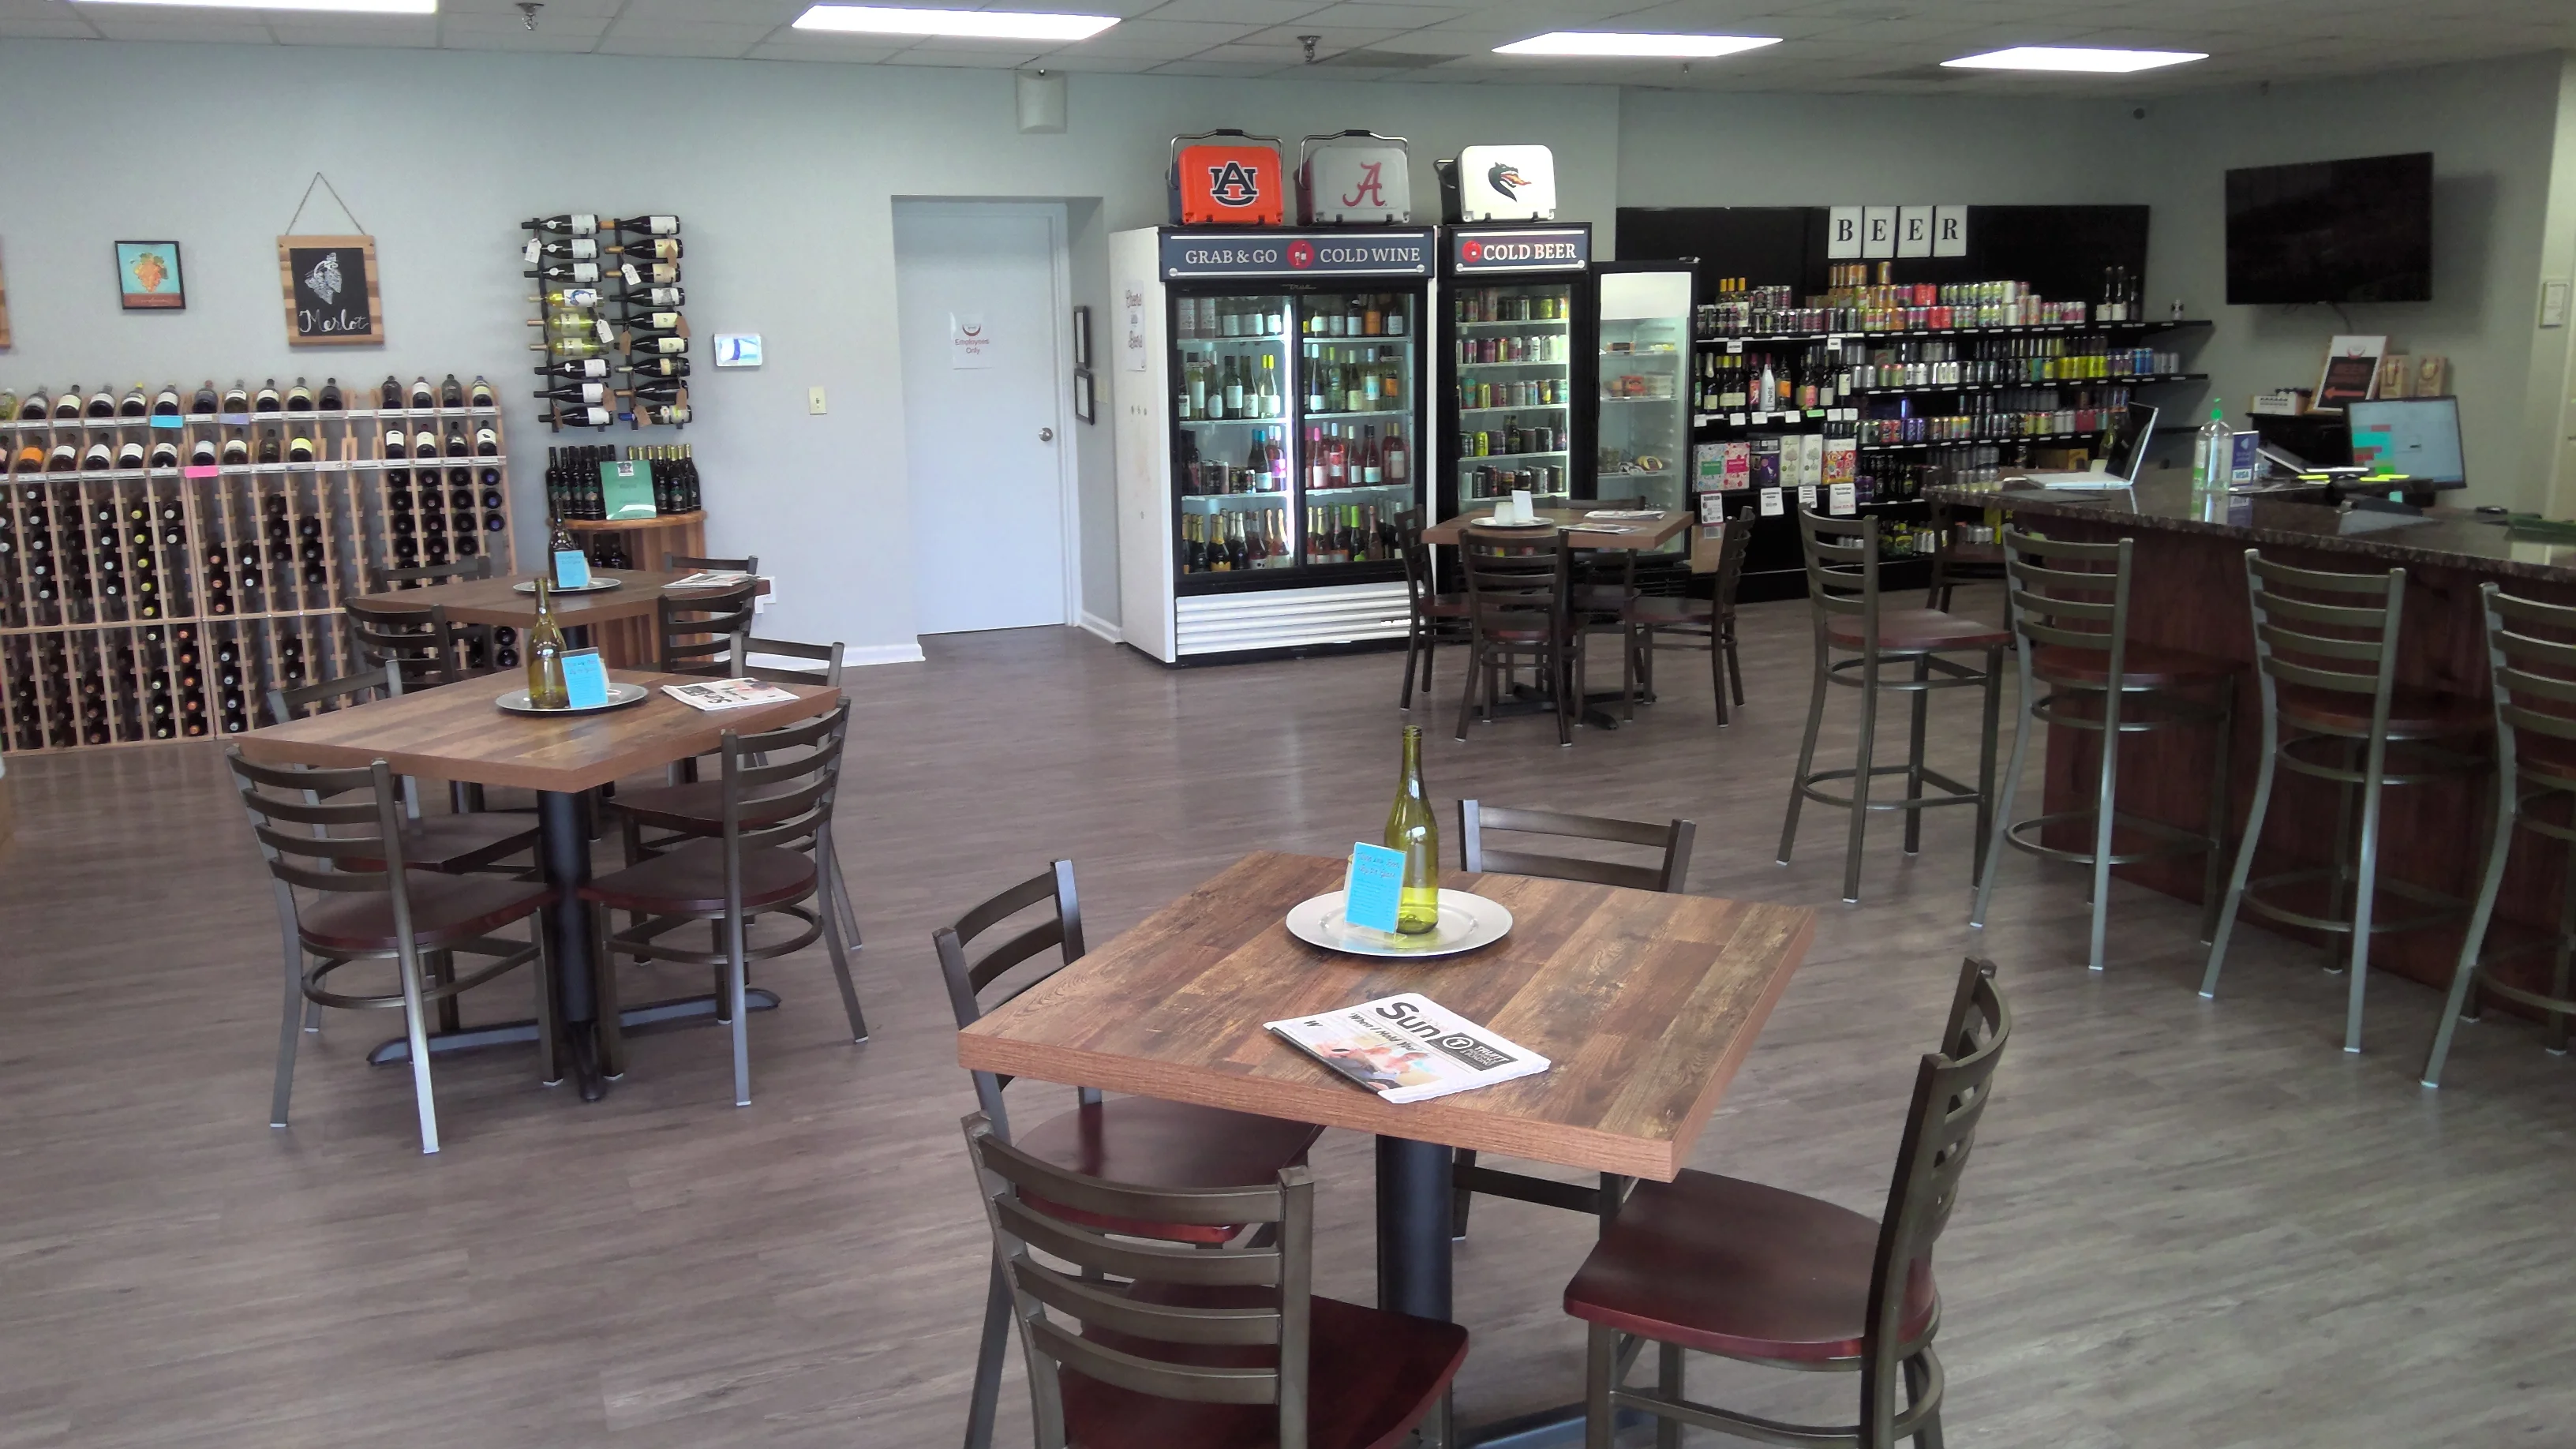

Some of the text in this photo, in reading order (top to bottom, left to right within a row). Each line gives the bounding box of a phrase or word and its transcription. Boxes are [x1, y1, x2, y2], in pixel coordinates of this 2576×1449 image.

[1837, 218, 1958, 242] BEER
[1185, 247, 1421, 264] GRAB & GO COLD WINE
[1483, 242, 1577, 261] COLD BEER
[298, 309, 369, 333] Merlot
[1376, 1002, 1441, 1040] Sun
